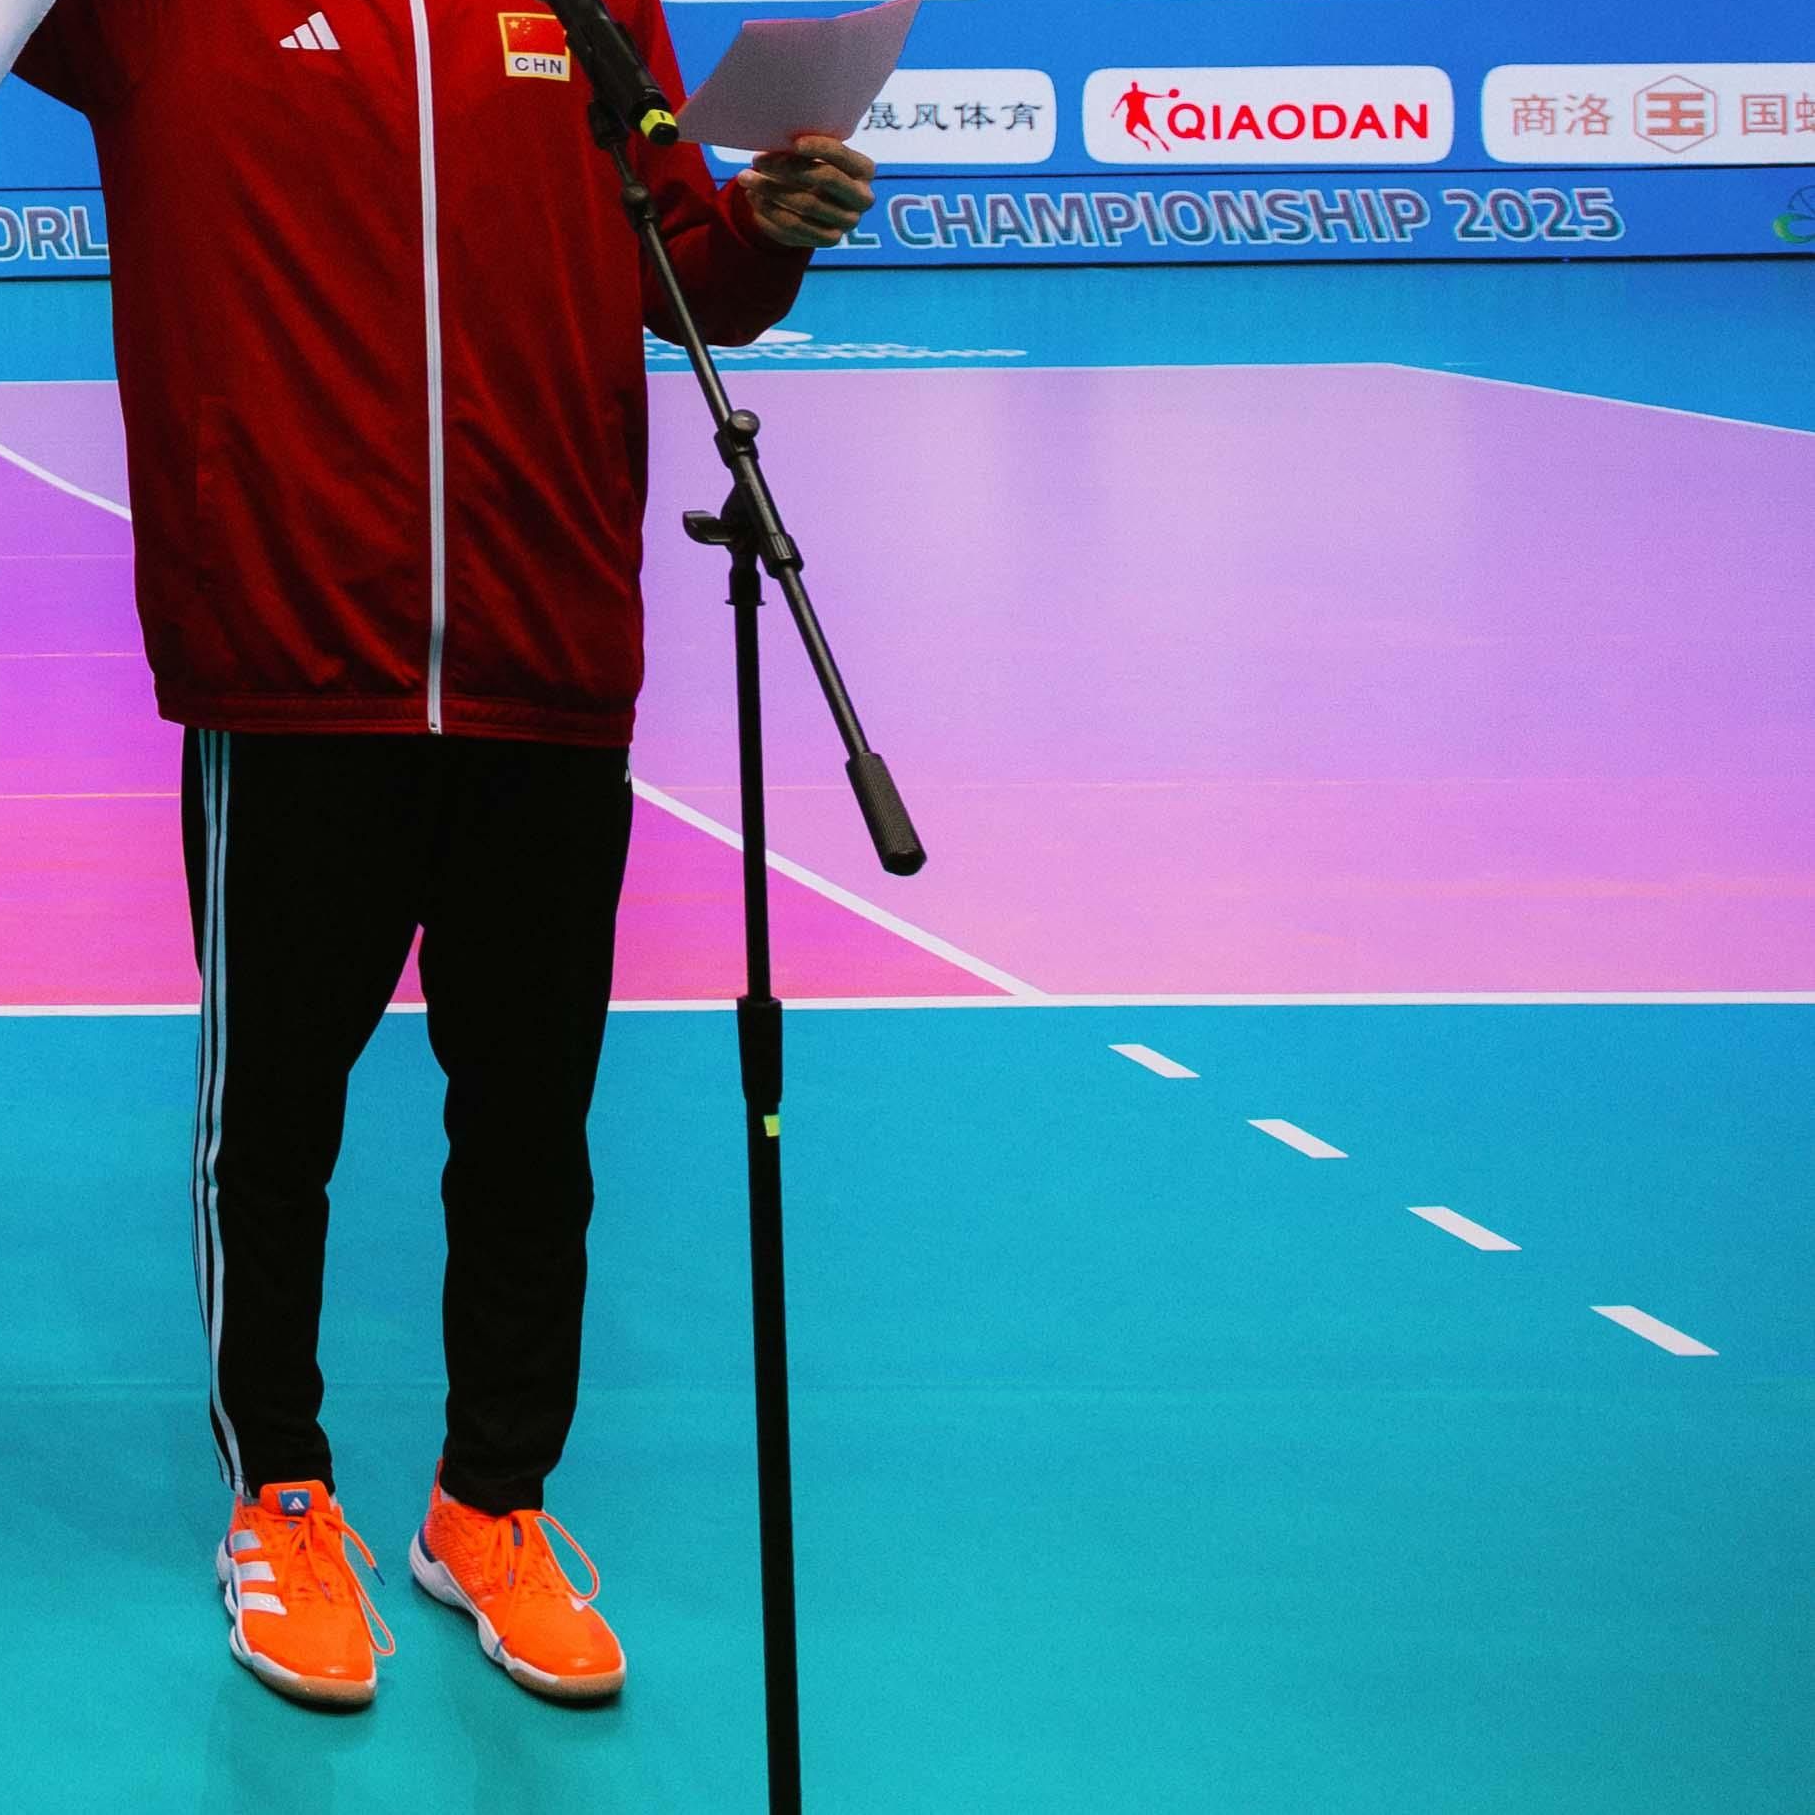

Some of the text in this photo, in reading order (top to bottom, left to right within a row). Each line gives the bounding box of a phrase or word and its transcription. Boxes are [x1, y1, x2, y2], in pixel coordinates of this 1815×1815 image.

[514, 57, 563, 74] CHN
[1167, 102, 1429, 141] QIAODAN
[1510, 93, 1614, 137] 商洛
[886, 186, 1627, 251] CHAMPIONSHIP 2025
